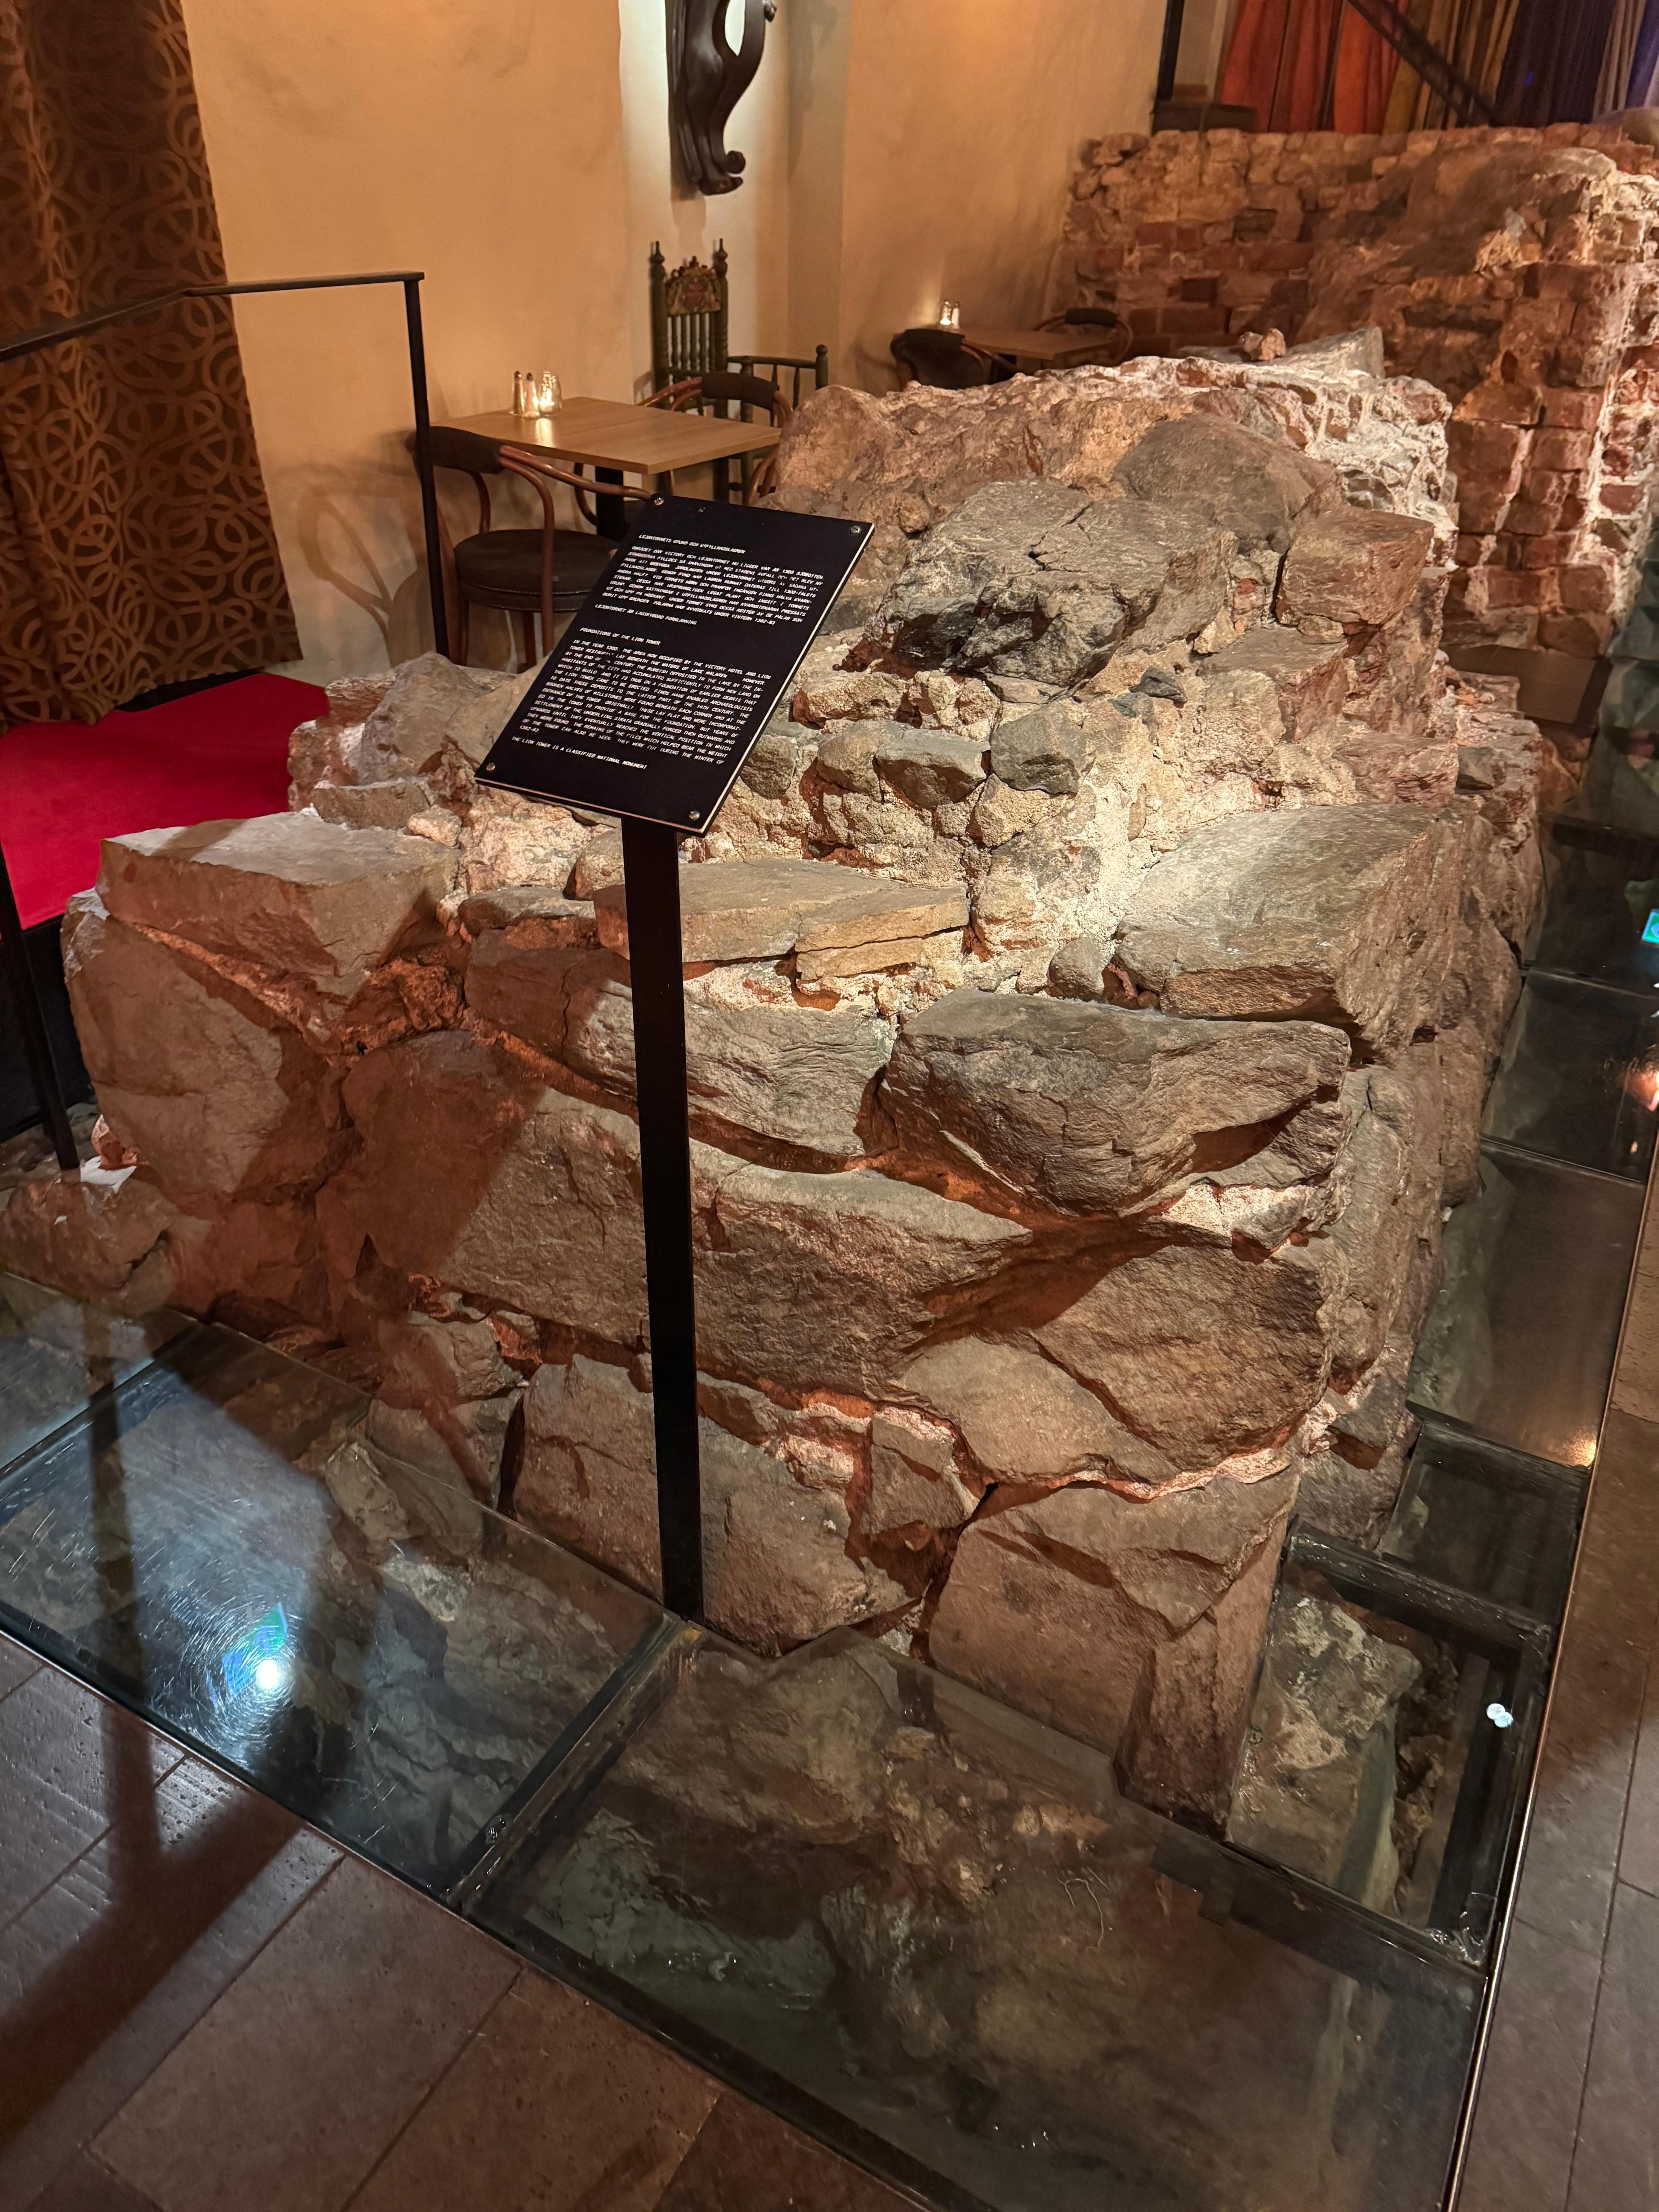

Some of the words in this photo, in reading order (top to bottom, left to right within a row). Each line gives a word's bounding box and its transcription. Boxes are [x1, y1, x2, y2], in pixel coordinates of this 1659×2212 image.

[580, 627, 611, 636] FOUNDATIONS
[669, 671, 697, 680] DEPOSITED
[666, 677, 702, 687] SUFFICIENTLY
[658, 683, 689, 692] FOUNDATION
[592, 691, 622, 700] MILLSTONES
[605, 700, 634, 709] ORIGINALLY
[710, 700, 753, 712] ARCHAEOLOGISTS
[583, 710, 613, 720] UNDERLYING
[697, 733, 723, 742] OUTWARDS
[584, 724, 605, 732] REMAINS
[584, 717, 614, 726] EVENTUALLY
[652, 732, 675, 740] VERTICAL
[678, 737, 704, 745] POSITION
[565, 748, 596, 758] CLASSIFIED
[596, 755, 620, 764] NATIONAL
